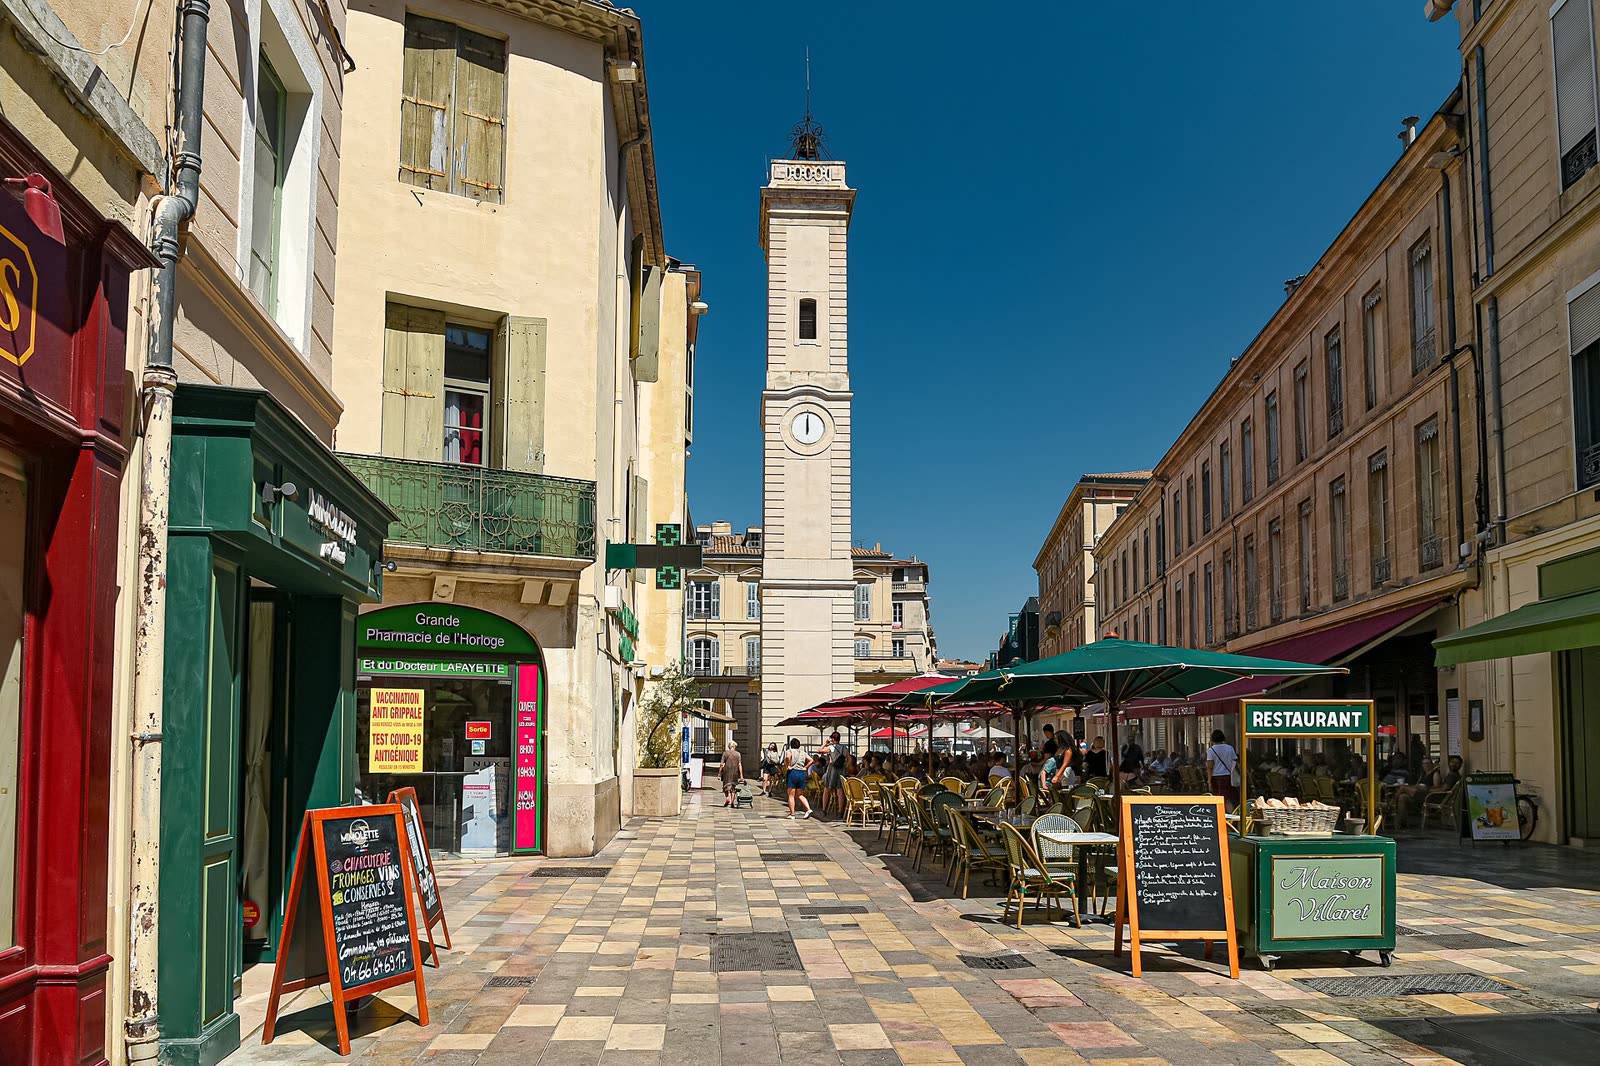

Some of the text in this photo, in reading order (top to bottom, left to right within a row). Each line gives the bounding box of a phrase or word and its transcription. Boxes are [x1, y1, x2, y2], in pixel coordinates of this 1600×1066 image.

[415, 613, 460, 626] Grande
[366, 628, 505, 649] Pharmacie de l'Horloge
[363, 659, 505, 673] Et du Docteur LAFAYETTE
[375, 692, 420, 704] VACCINATION
[372, 707, 422, 719] ANTI GRIPPALE
[518, 701, 536, 712] OUVERT
[1252, 711, 1363, 728] RESTAURANT
[372, 733, 422, 746] TEST COVID-19
[374, 746, 419, 762] ANTIGÉNIQUE
[517, 766, 535, 777] 19H30
[518, 790, 533, 800] NON
[516, 799, 535, 810] STOP
[340, 829, 380, 842] MIMOLETTE
[332, 869, 375, 889] FROMAGES
[1280, 865, 1372, 890] Maison
[343, 882, 386, 904] CONSERVES
[1288, 894, 1370, 922] Villaret
